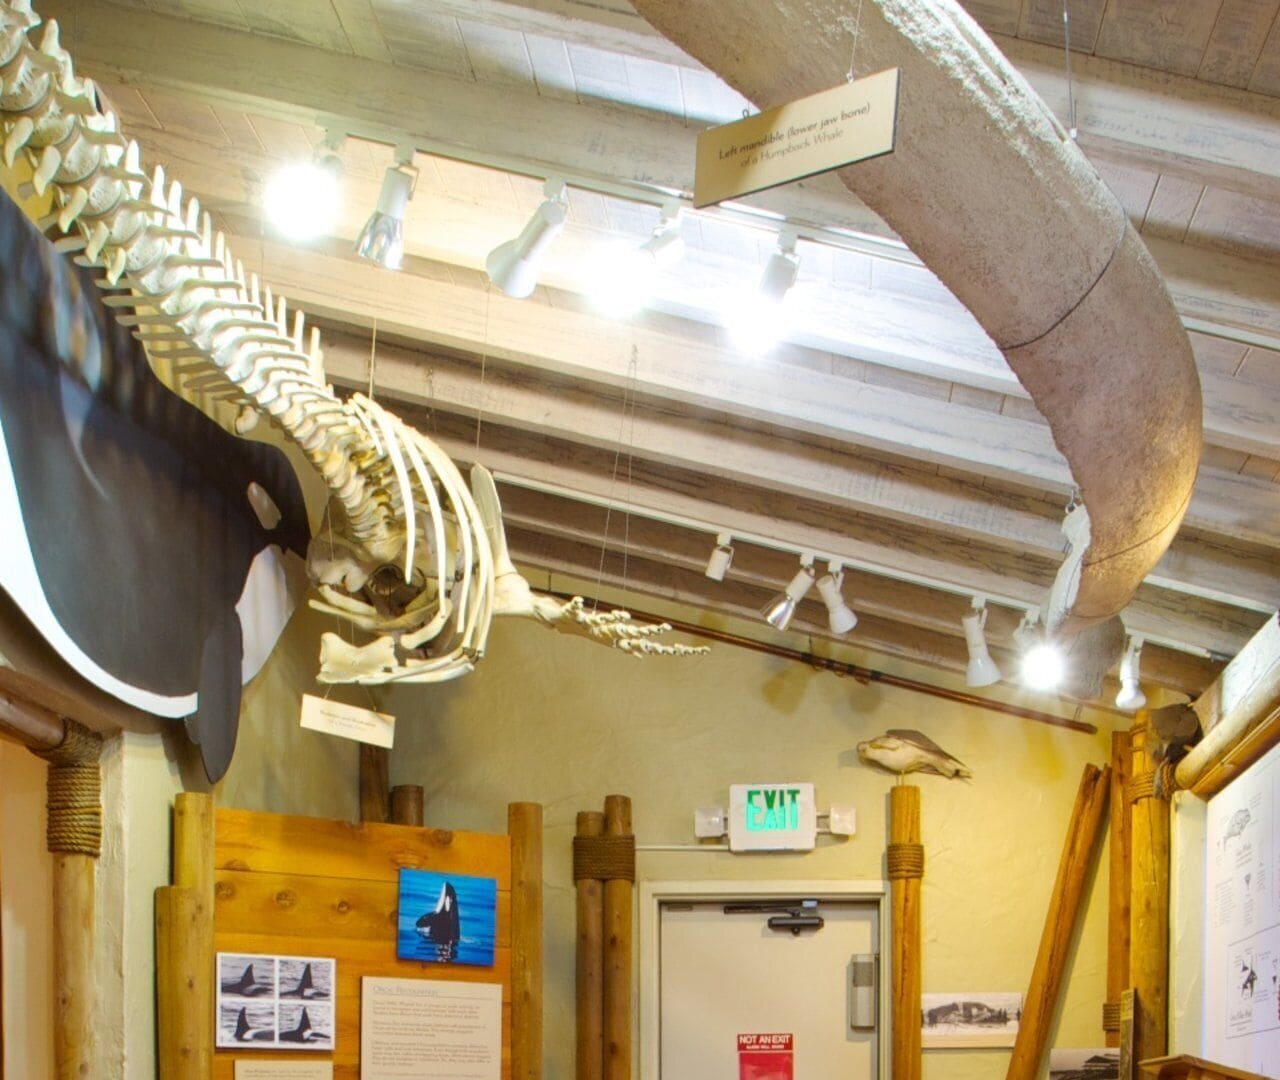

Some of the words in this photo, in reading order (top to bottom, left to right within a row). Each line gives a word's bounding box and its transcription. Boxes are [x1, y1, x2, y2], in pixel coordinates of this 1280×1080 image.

[718, 144, 738, 160] Left
[739, 131, 784, 152] mandible
[786, 122, 817, 138] (lower
[819, 116, 837, 127] jaw
[840, 101, 870, 120] bone)
[746, 789, 800, 831] EXIT
[740, 1035, 758, 1044] NOT
[759, 1035, 771, 1044] AN
[772, 1034, 791, 1044] EXIT
